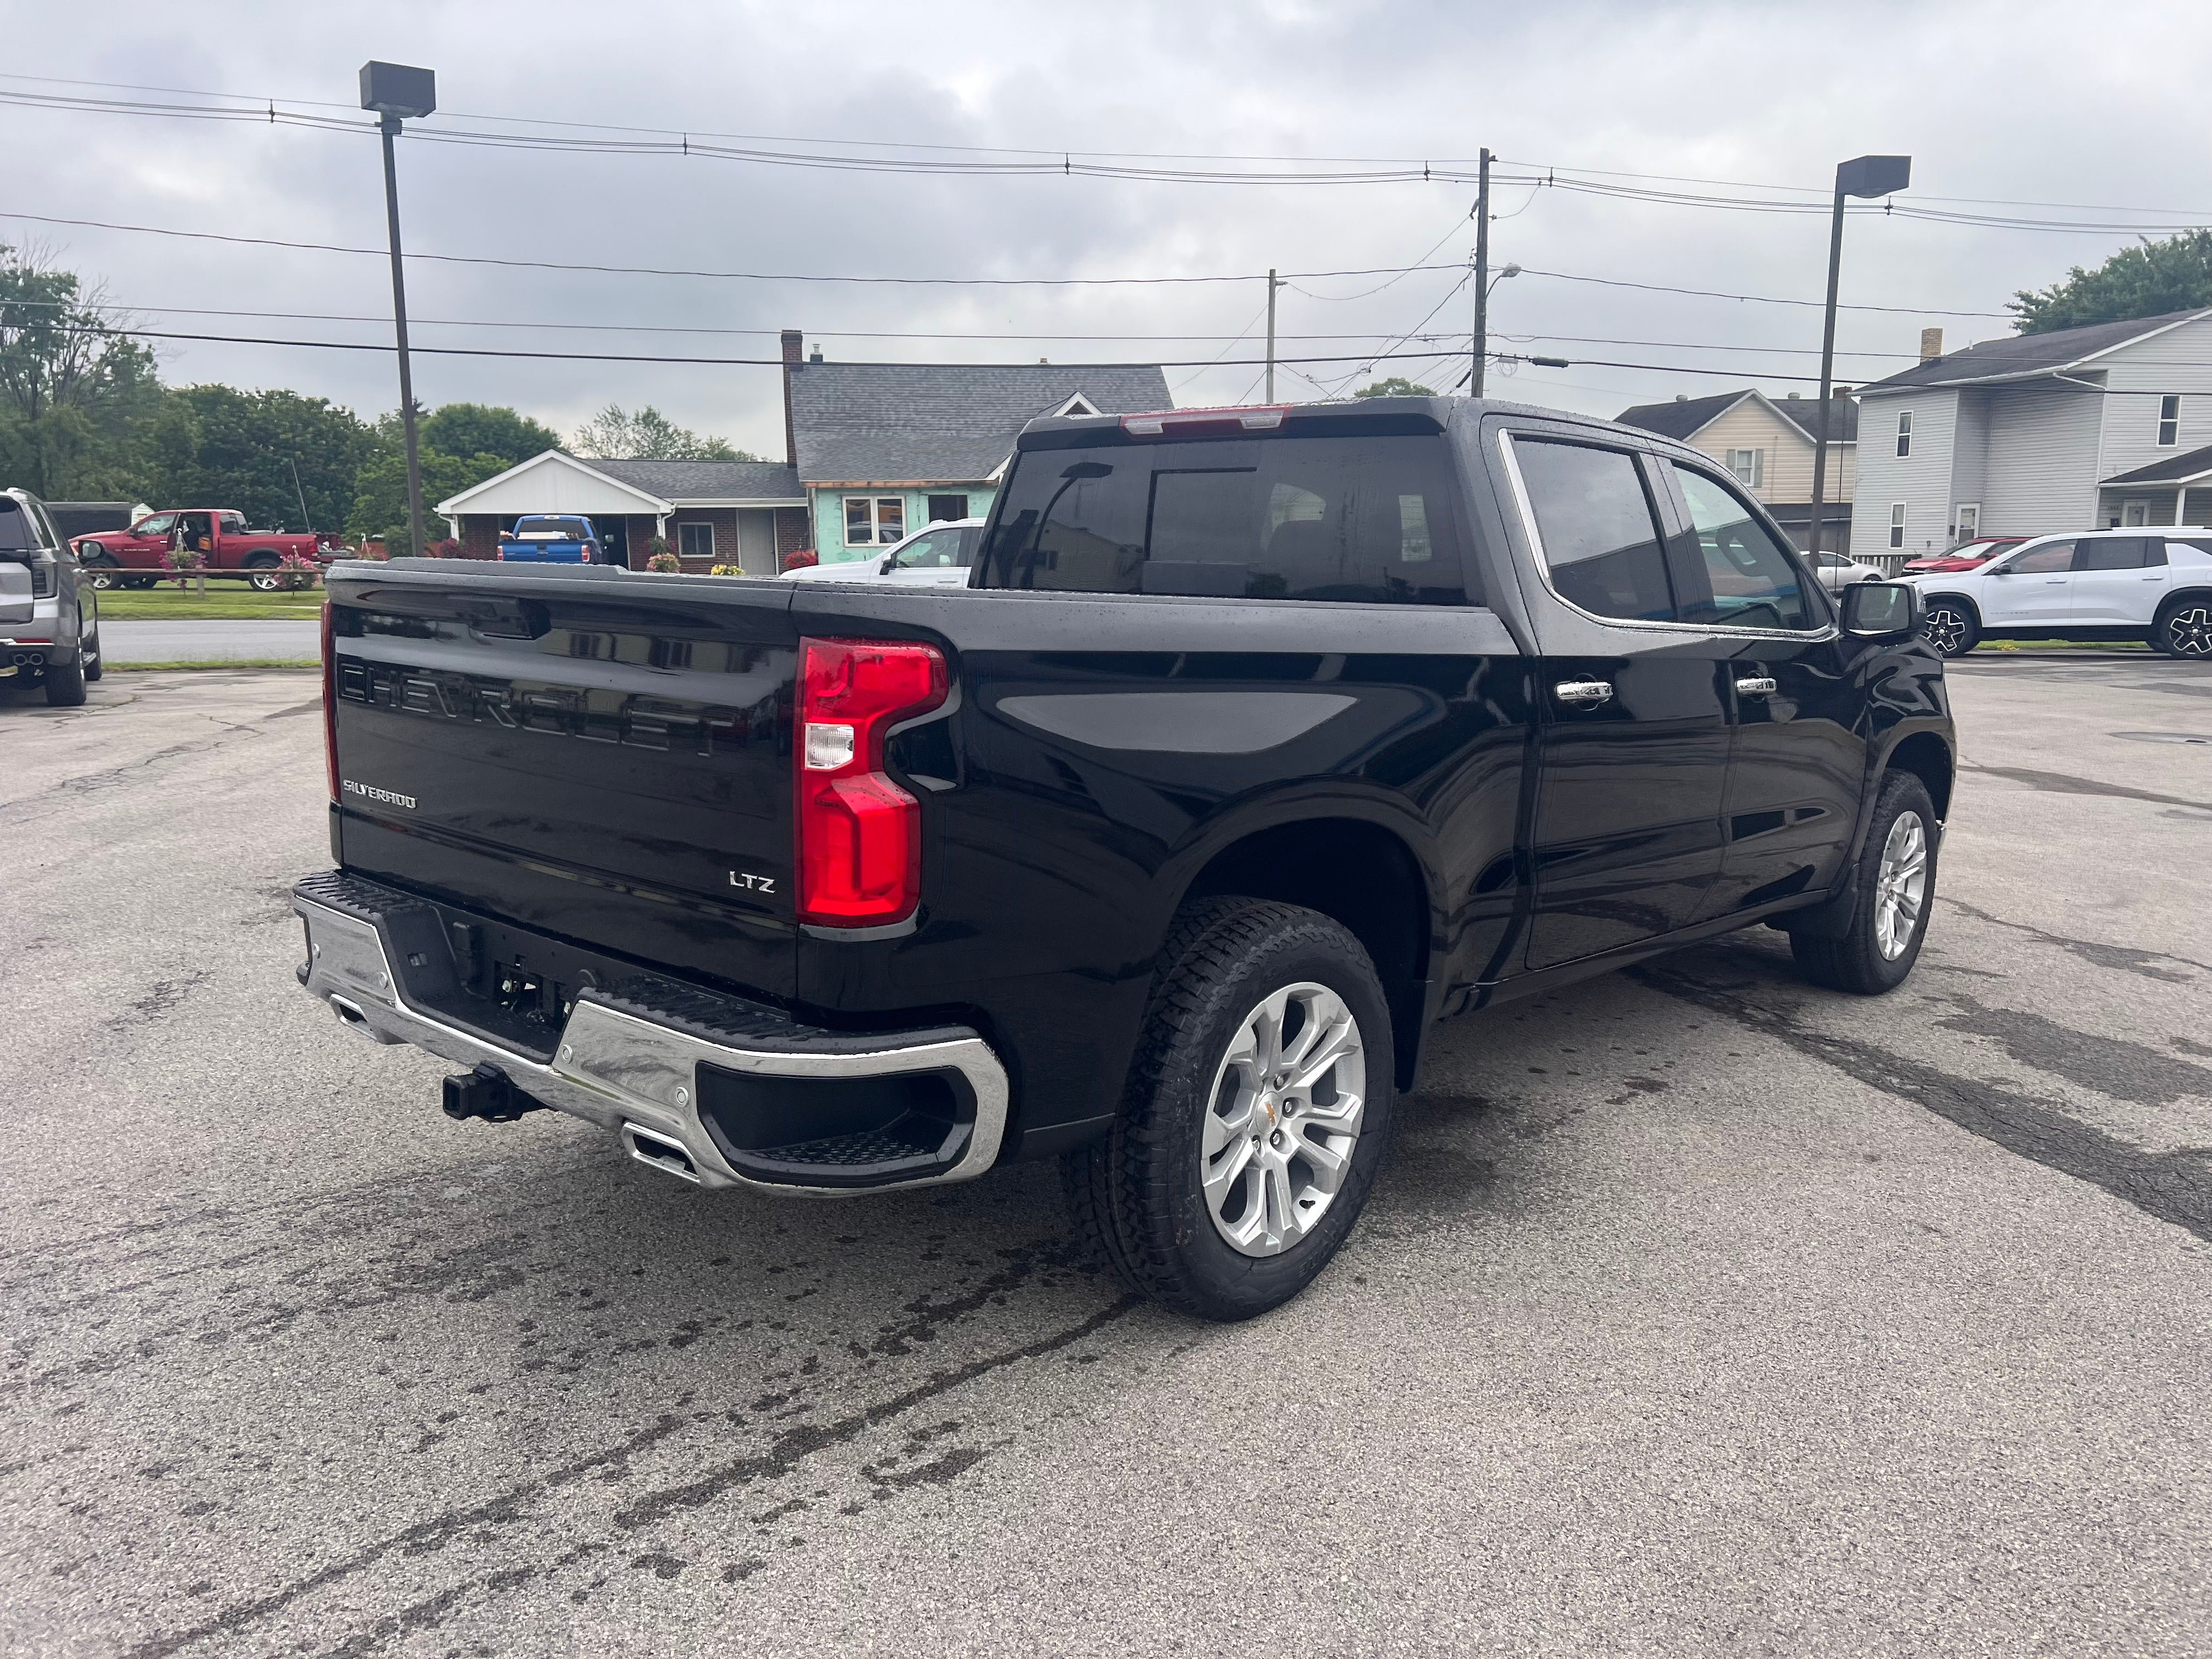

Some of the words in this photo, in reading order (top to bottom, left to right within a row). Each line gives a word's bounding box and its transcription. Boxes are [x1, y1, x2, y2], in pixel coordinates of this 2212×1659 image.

[340, 663, 736, 757] CHEVROLET
[343, 779, 416, 809] SILVERADO
[730, 871, 776, 894] LTZ
